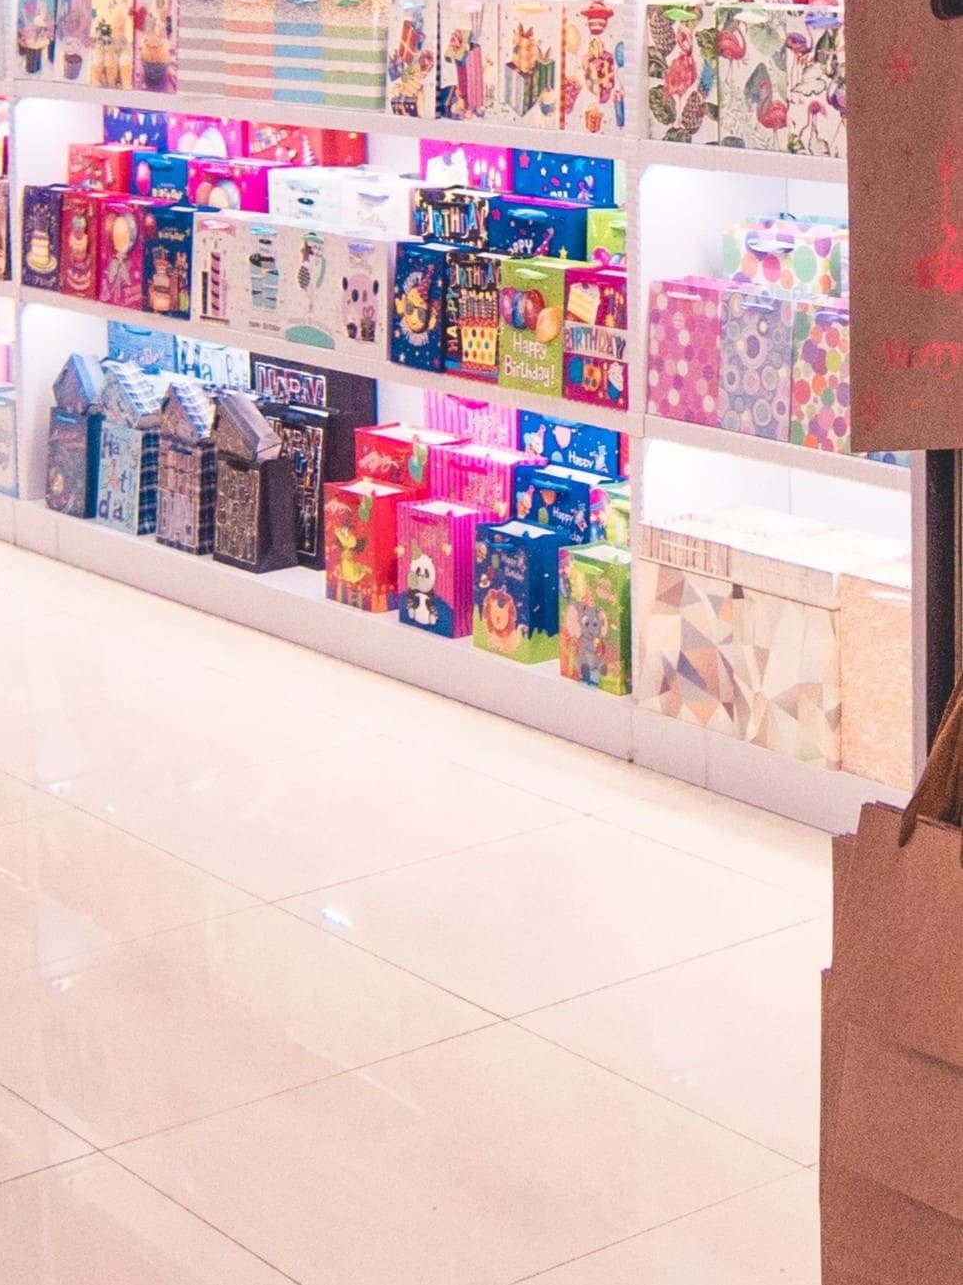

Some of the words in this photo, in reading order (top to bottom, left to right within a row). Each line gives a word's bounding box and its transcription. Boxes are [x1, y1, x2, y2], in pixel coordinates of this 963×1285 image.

[512, 331, 547, 359] Happy
[564, 325, 627, 360] BIRTHDAY
[503, 353, 555, 388] Birthday!
[568, 450, 595, 469] Happy
[552, 506, 574, 526] Happy
